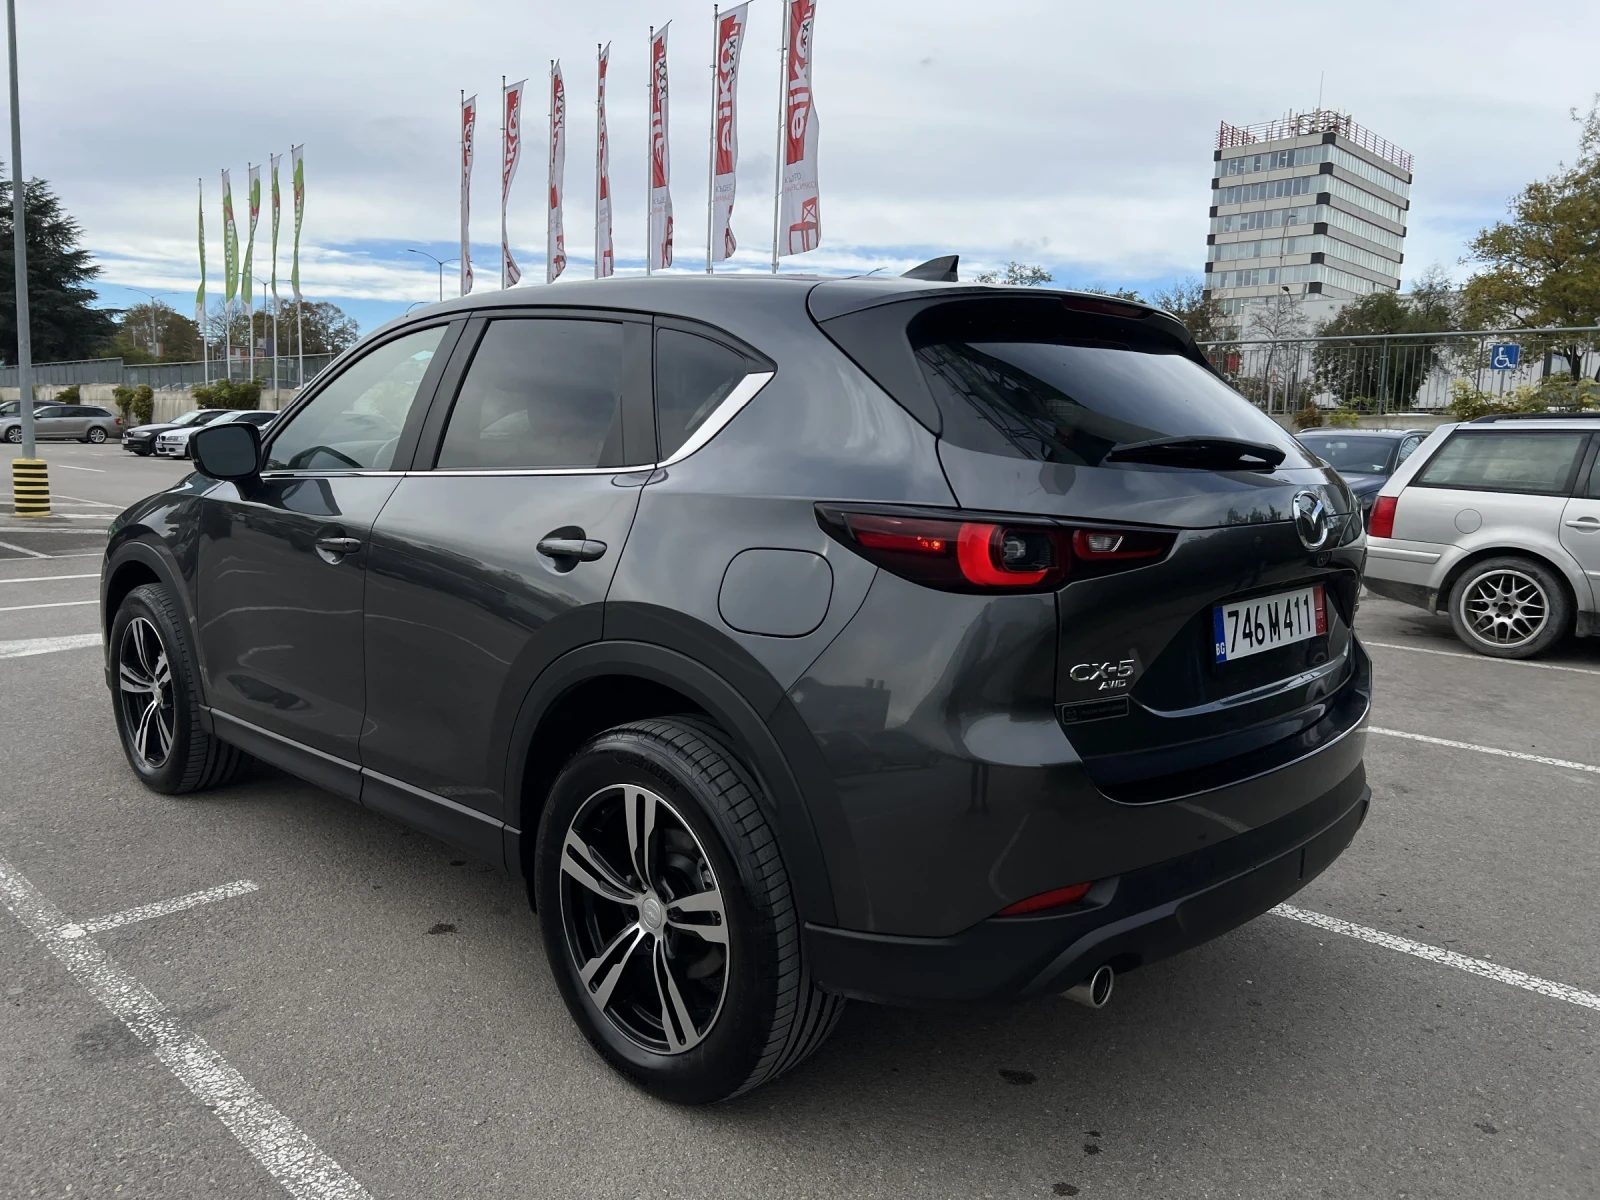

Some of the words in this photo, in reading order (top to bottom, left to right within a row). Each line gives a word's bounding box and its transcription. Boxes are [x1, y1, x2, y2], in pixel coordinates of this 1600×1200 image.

[1227, 594, 1311, 653] 746M411
[1215, 641, 1226, 656] BG
[1069, 658, 1135, 682] CX-5
[1097, 679, 1127, 691] AWD
